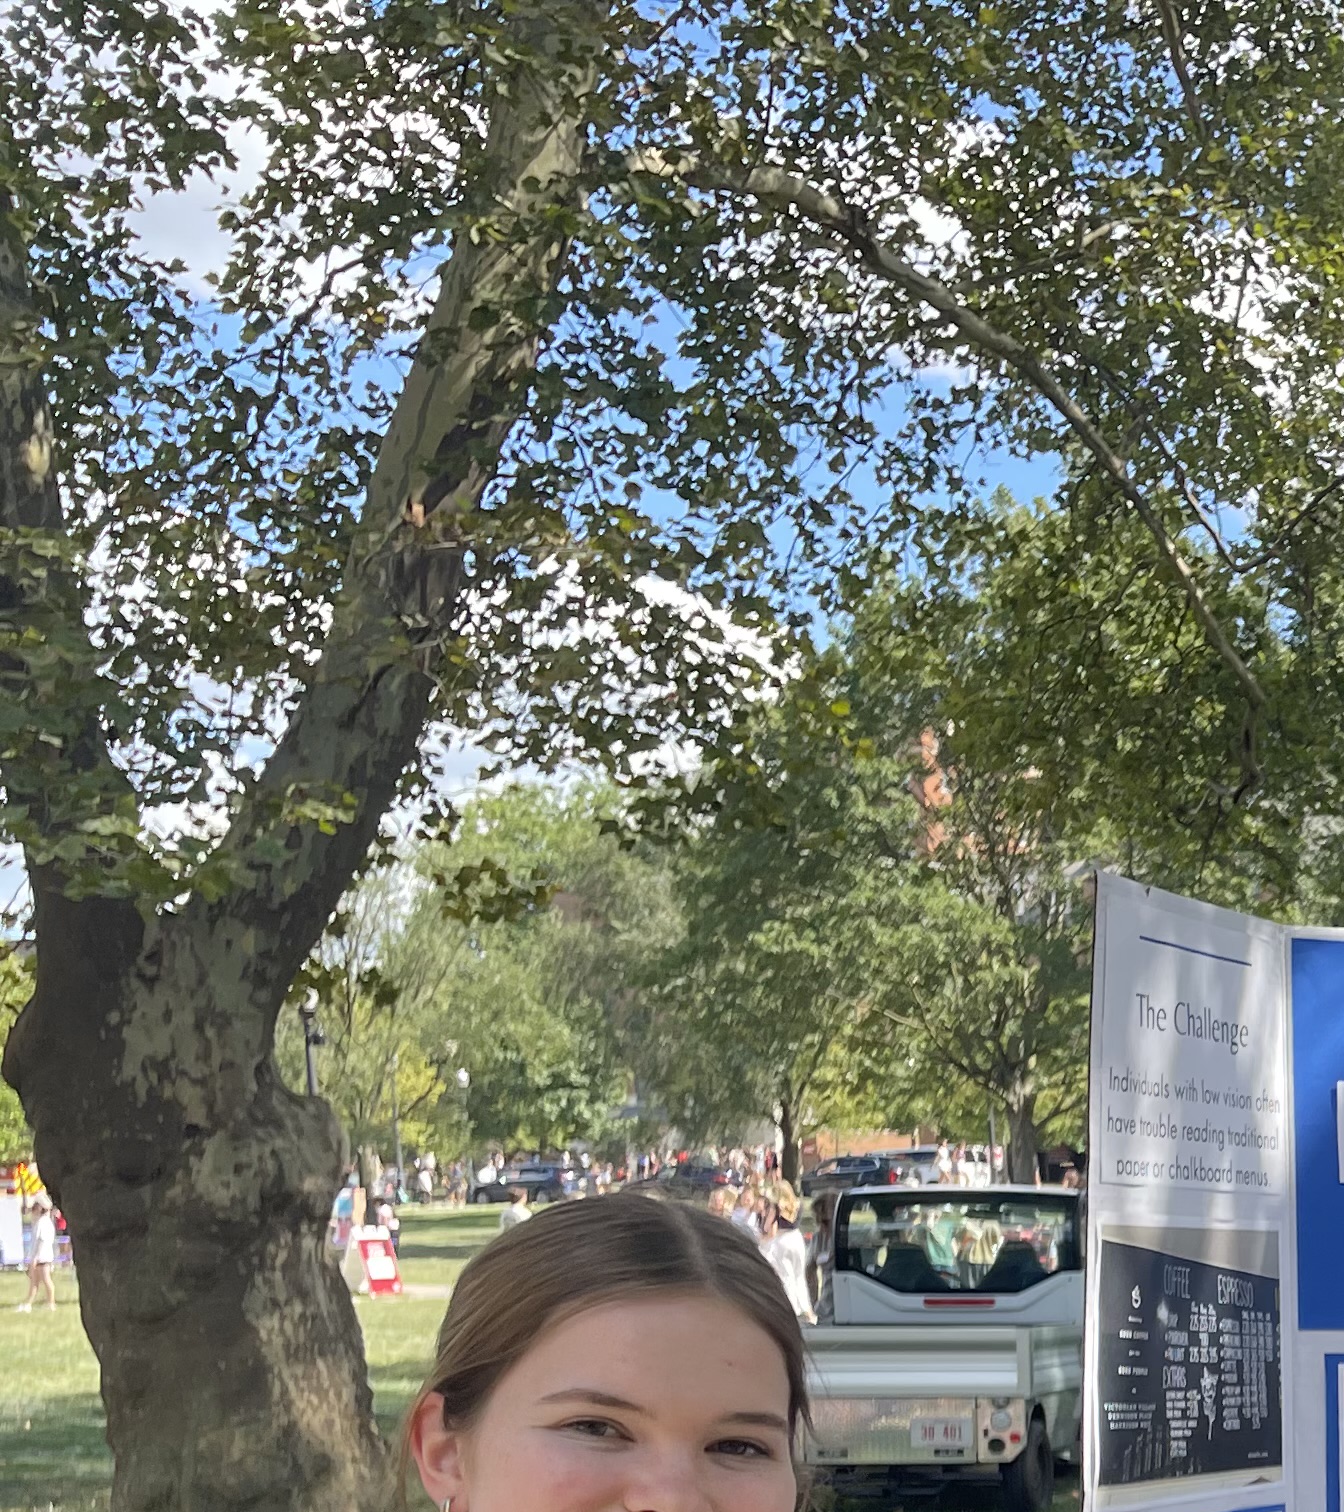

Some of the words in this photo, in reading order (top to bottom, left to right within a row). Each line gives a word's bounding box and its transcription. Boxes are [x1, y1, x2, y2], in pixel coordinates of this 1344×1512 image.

[1136, 993, 1167, 1031] The
[1174, 1001, 1249, 1055] Challenge
[1109, 1066, 1169, 1099] Individuals
[1174, 1077, 1198, 1102] with
[1201, 1079, 1220, 1105] low
[1223, 1086, 1252, 1110] vision
[1255, 1088, 1281, 1113] often
[1106, 1106, 1136, 1135] have
[1139, 1113, 1178, 1140] trouble
[1181, 1118, 1225, 1152] reading
[1227, 1124, 1279, 1151] traditional
[1116, 1157, 1148, 1178] paper
[1152, 1160, 1164, 1178] or
[1168, 1155, 1233, 1184] chalkboard
